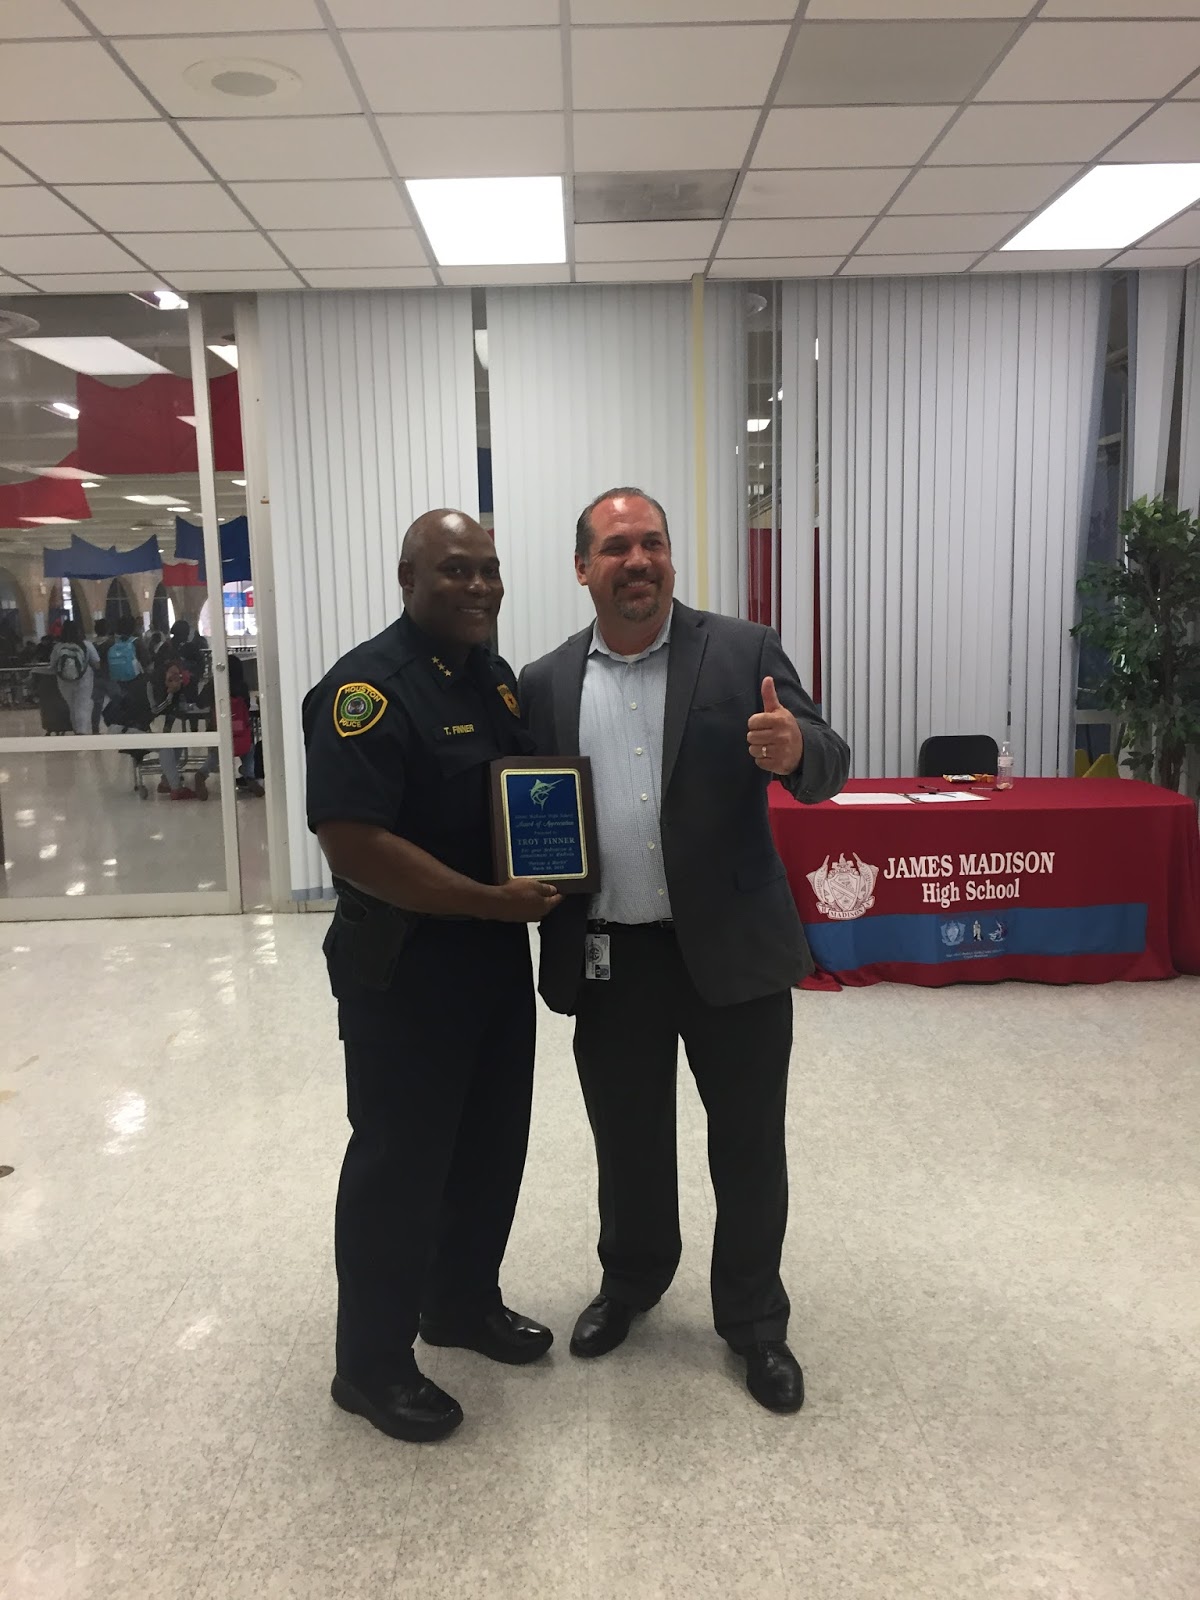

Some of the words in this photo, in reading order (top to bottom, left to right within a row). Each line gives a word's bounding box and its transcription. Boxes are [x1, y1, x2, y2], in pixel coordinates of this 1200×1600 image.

[344, 686, 381, 702] HOUSTON
[339, 718, 361, 727] POLICE
[444, 727, 452, 735] T.
[452, 724, 475, 734] FINNER
[543, 837, 575, 845] FINNER
[883, 855, 954, 879] JAMES
[959, 851, 1055, 875] MADISON
[922, 880, 960, 908] High
[965, 878, 1020, 901] School
[830, 908, 864, 918] MADISON
